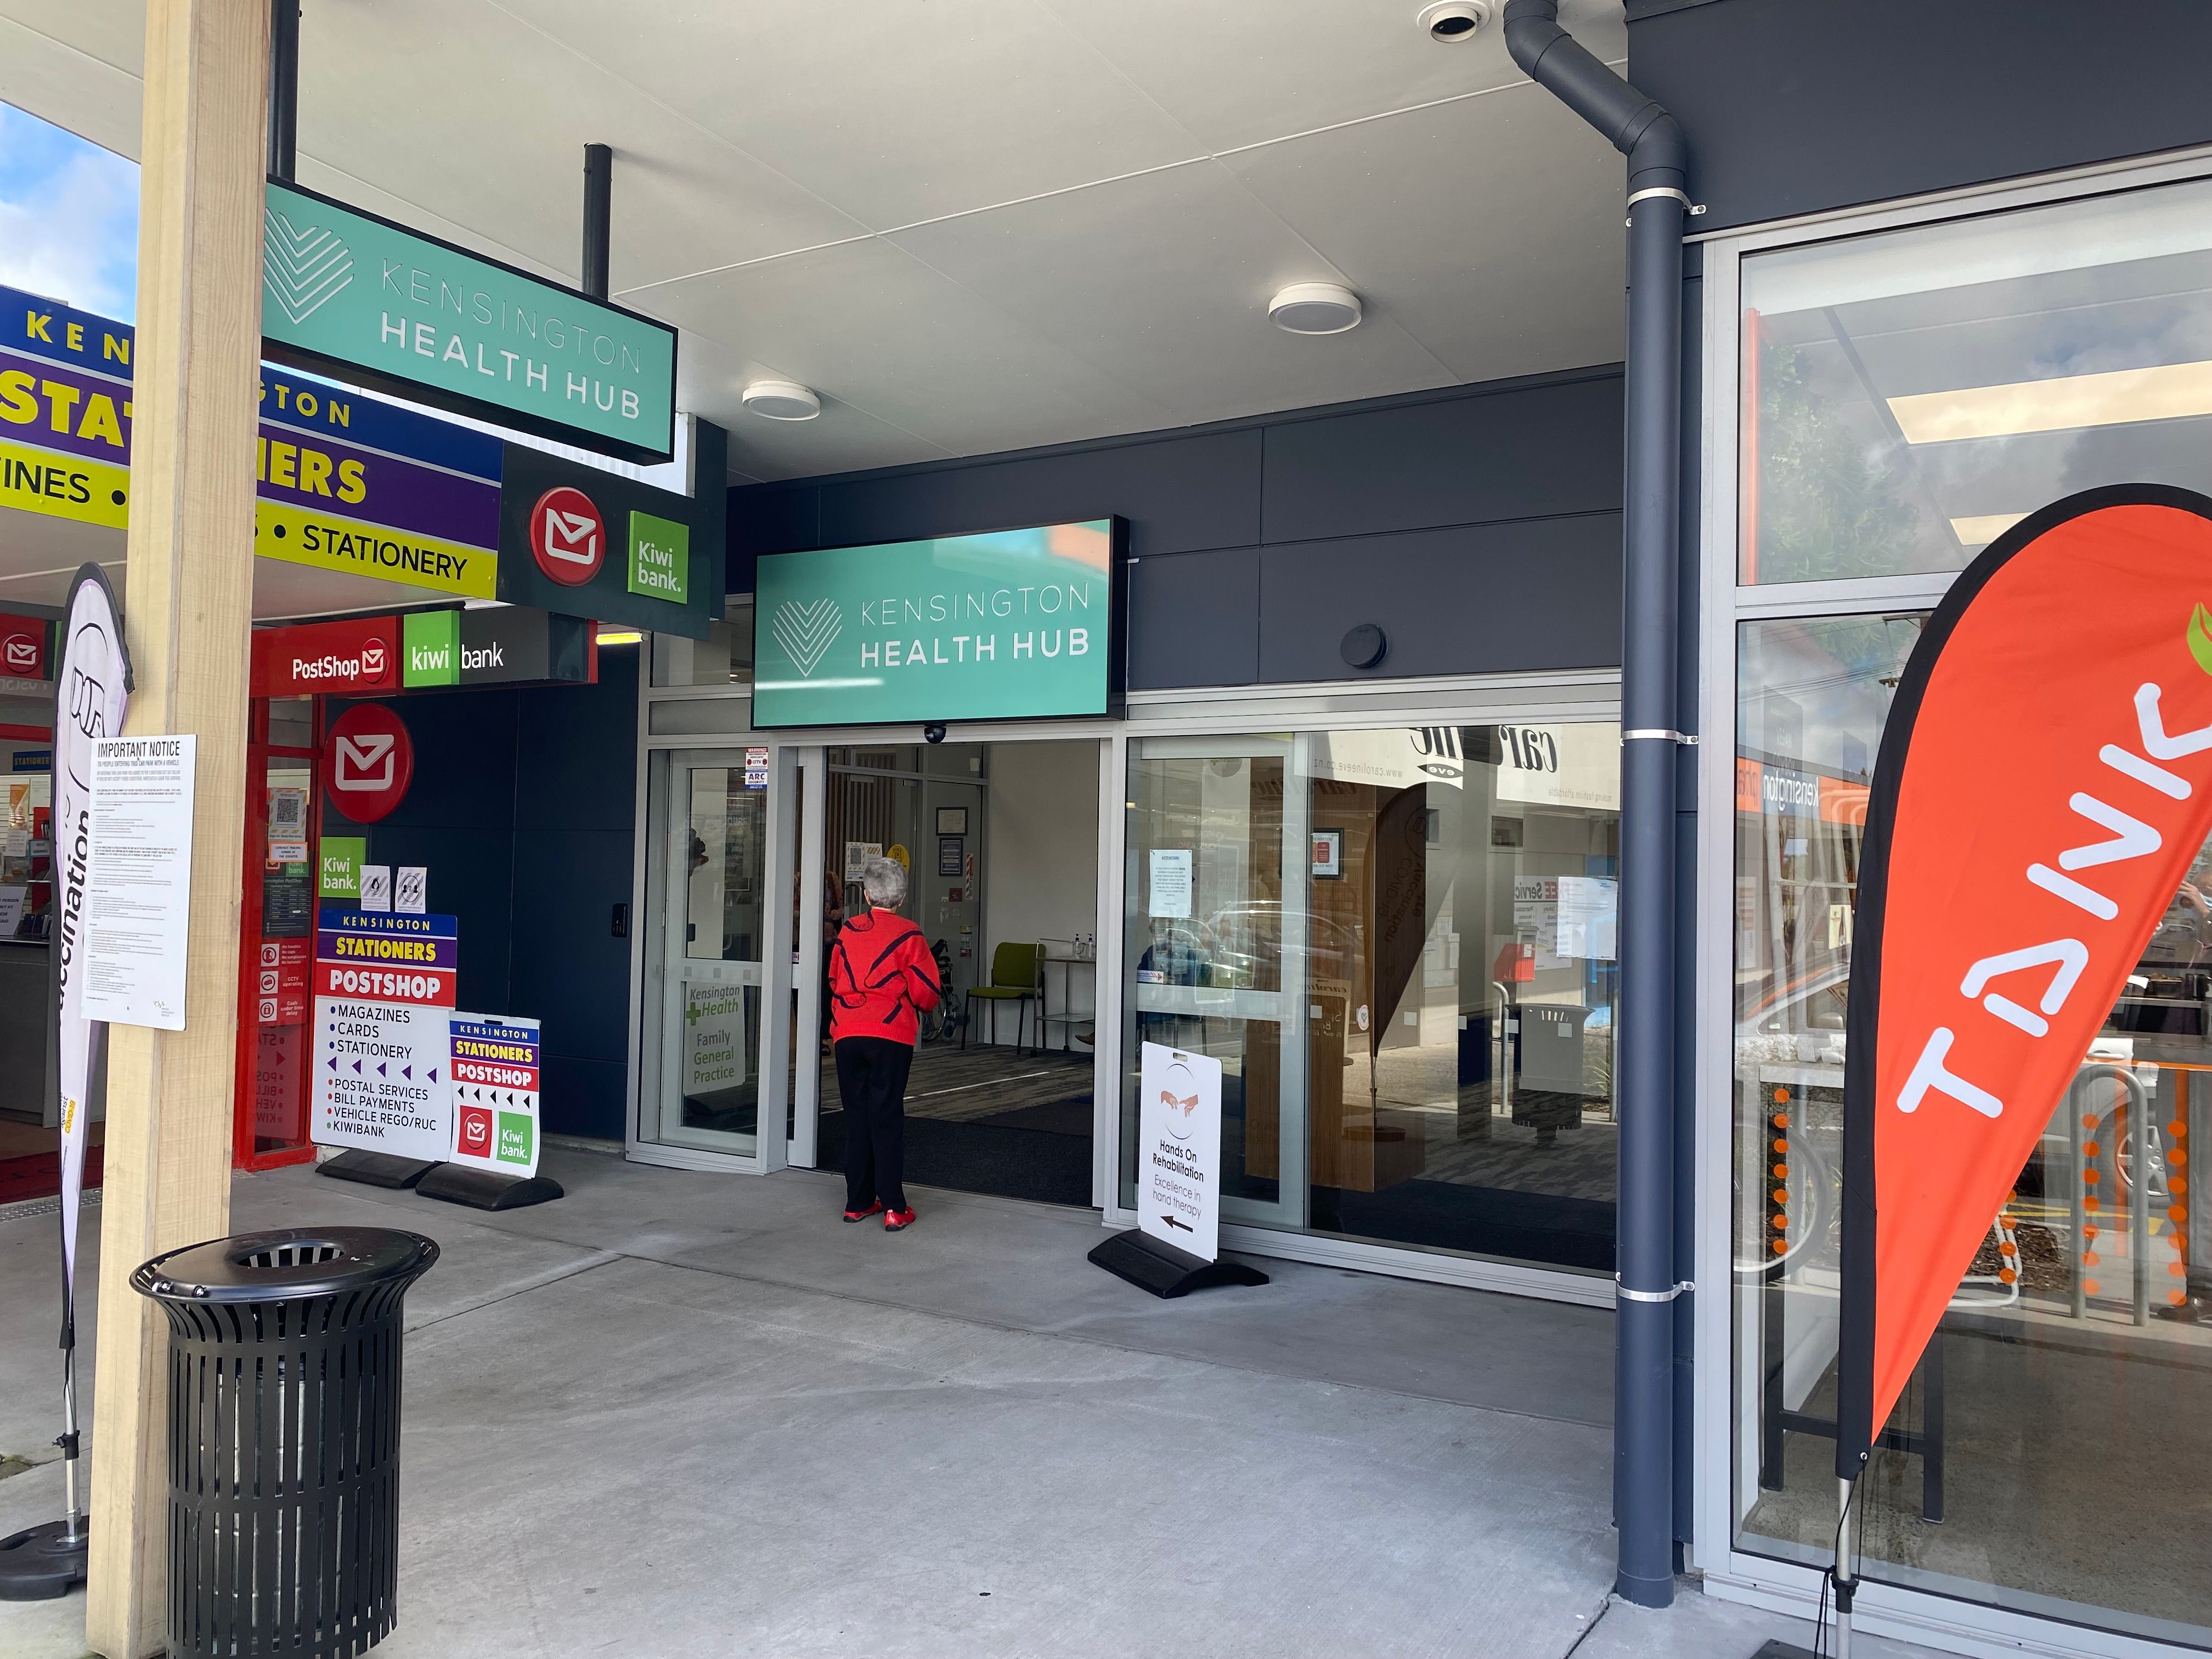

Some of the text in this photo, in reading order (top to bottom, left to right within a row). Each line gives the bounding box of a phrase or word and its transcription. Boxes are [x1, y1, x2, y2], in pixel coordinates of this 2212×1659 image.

[383, 258, 640, 374] KENSINGTON
[381, 311, 640, 420] HEALTH HUB
[0, 456, 90, 504] INES
[302, 524, 467, 581] STATIONERY
[638, 540, 673, 568] Kiwi
[637, 566, 682, 593] bank.
[861, 582, 1088, 627] KENSINGTON
[860, 627, 1089, 668] HEALTH HUB
[292, 655, 359, 681] PostShop
[98, 741, 180, 758] IMPORTANT NOTICE
[324, 857, 350, 873] Kiwi
[323, 873, 357, 890] bank.
[1897, 682, 2212, 1118] TANK
[343, 916, 431, 932] KENSINGTON
[336, 936, 436, 962] STATIONERS
[330, 969, 441, 1000] POSTSHOP
[690, 986, 740, 1001] Kensington
[338, 1004, 410, 1024] MAGAZINES
[702, 998, 738, 1017] Health
[338, 1023, 379, 1039] CARDS
[460, 1024, 528, 1040] KENSINGTON
[697, 1029, 730, 1047] Family
[337, 1040, 412, 1059] STATIONERY
[456, 1041, 533, 1062] STATIONERS
[694, 1046, 734, 1065] General
[457, 1063, 532, 1086] POSTSHOP
[694, 1066, 734, 1084] Practice
[335, 1079, 428, 1101] POSTAL SERVICES
[334, 1092, 415, 1114] BILL PAYMENTS
[65, 1099, 75, 1133] COVID-19
[334, 1107, 437, 1131] VEHICLE REGO/RUC
[333, 1121, 385, 1138] KIWIBANK
[502, 1128, 523, 1144] Kiwi
[500, 1142, 528, 1160] bank.
[1160, 1139, 1197, 1164] Hands On
[1153, 1152, 1204, 1182] Rehabilitation
[1154, 1173, 1201, 1203] Excellence in
[1153, 1188, 1201, 1221] hand therapy
